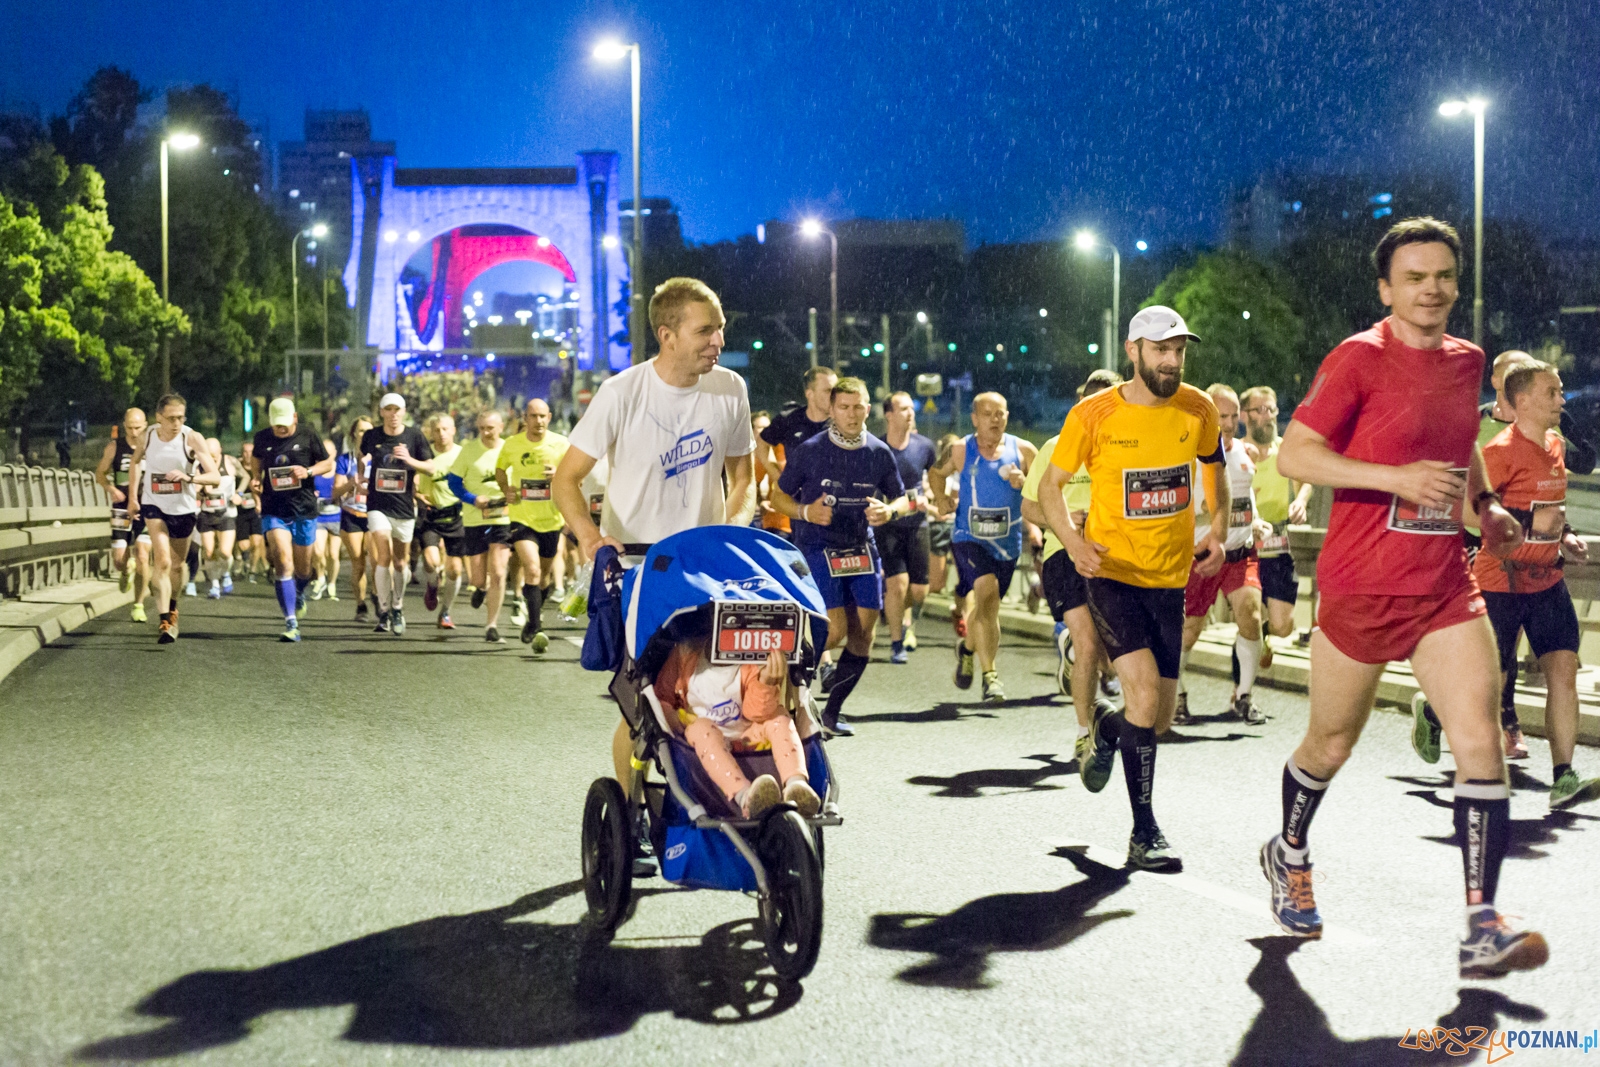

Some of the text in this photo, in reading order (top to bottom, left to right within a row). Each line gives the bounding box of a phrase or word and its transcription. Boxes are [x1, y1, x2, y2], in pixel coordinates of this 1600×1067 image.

[659, 435, 714, 467] WILDA
[1141, 489, 1177, 508] 2440
[978, 522, 1000, 533] 7902
[840, 556, 862, 569] 2113
[733, 630, 783, 651] 10163
